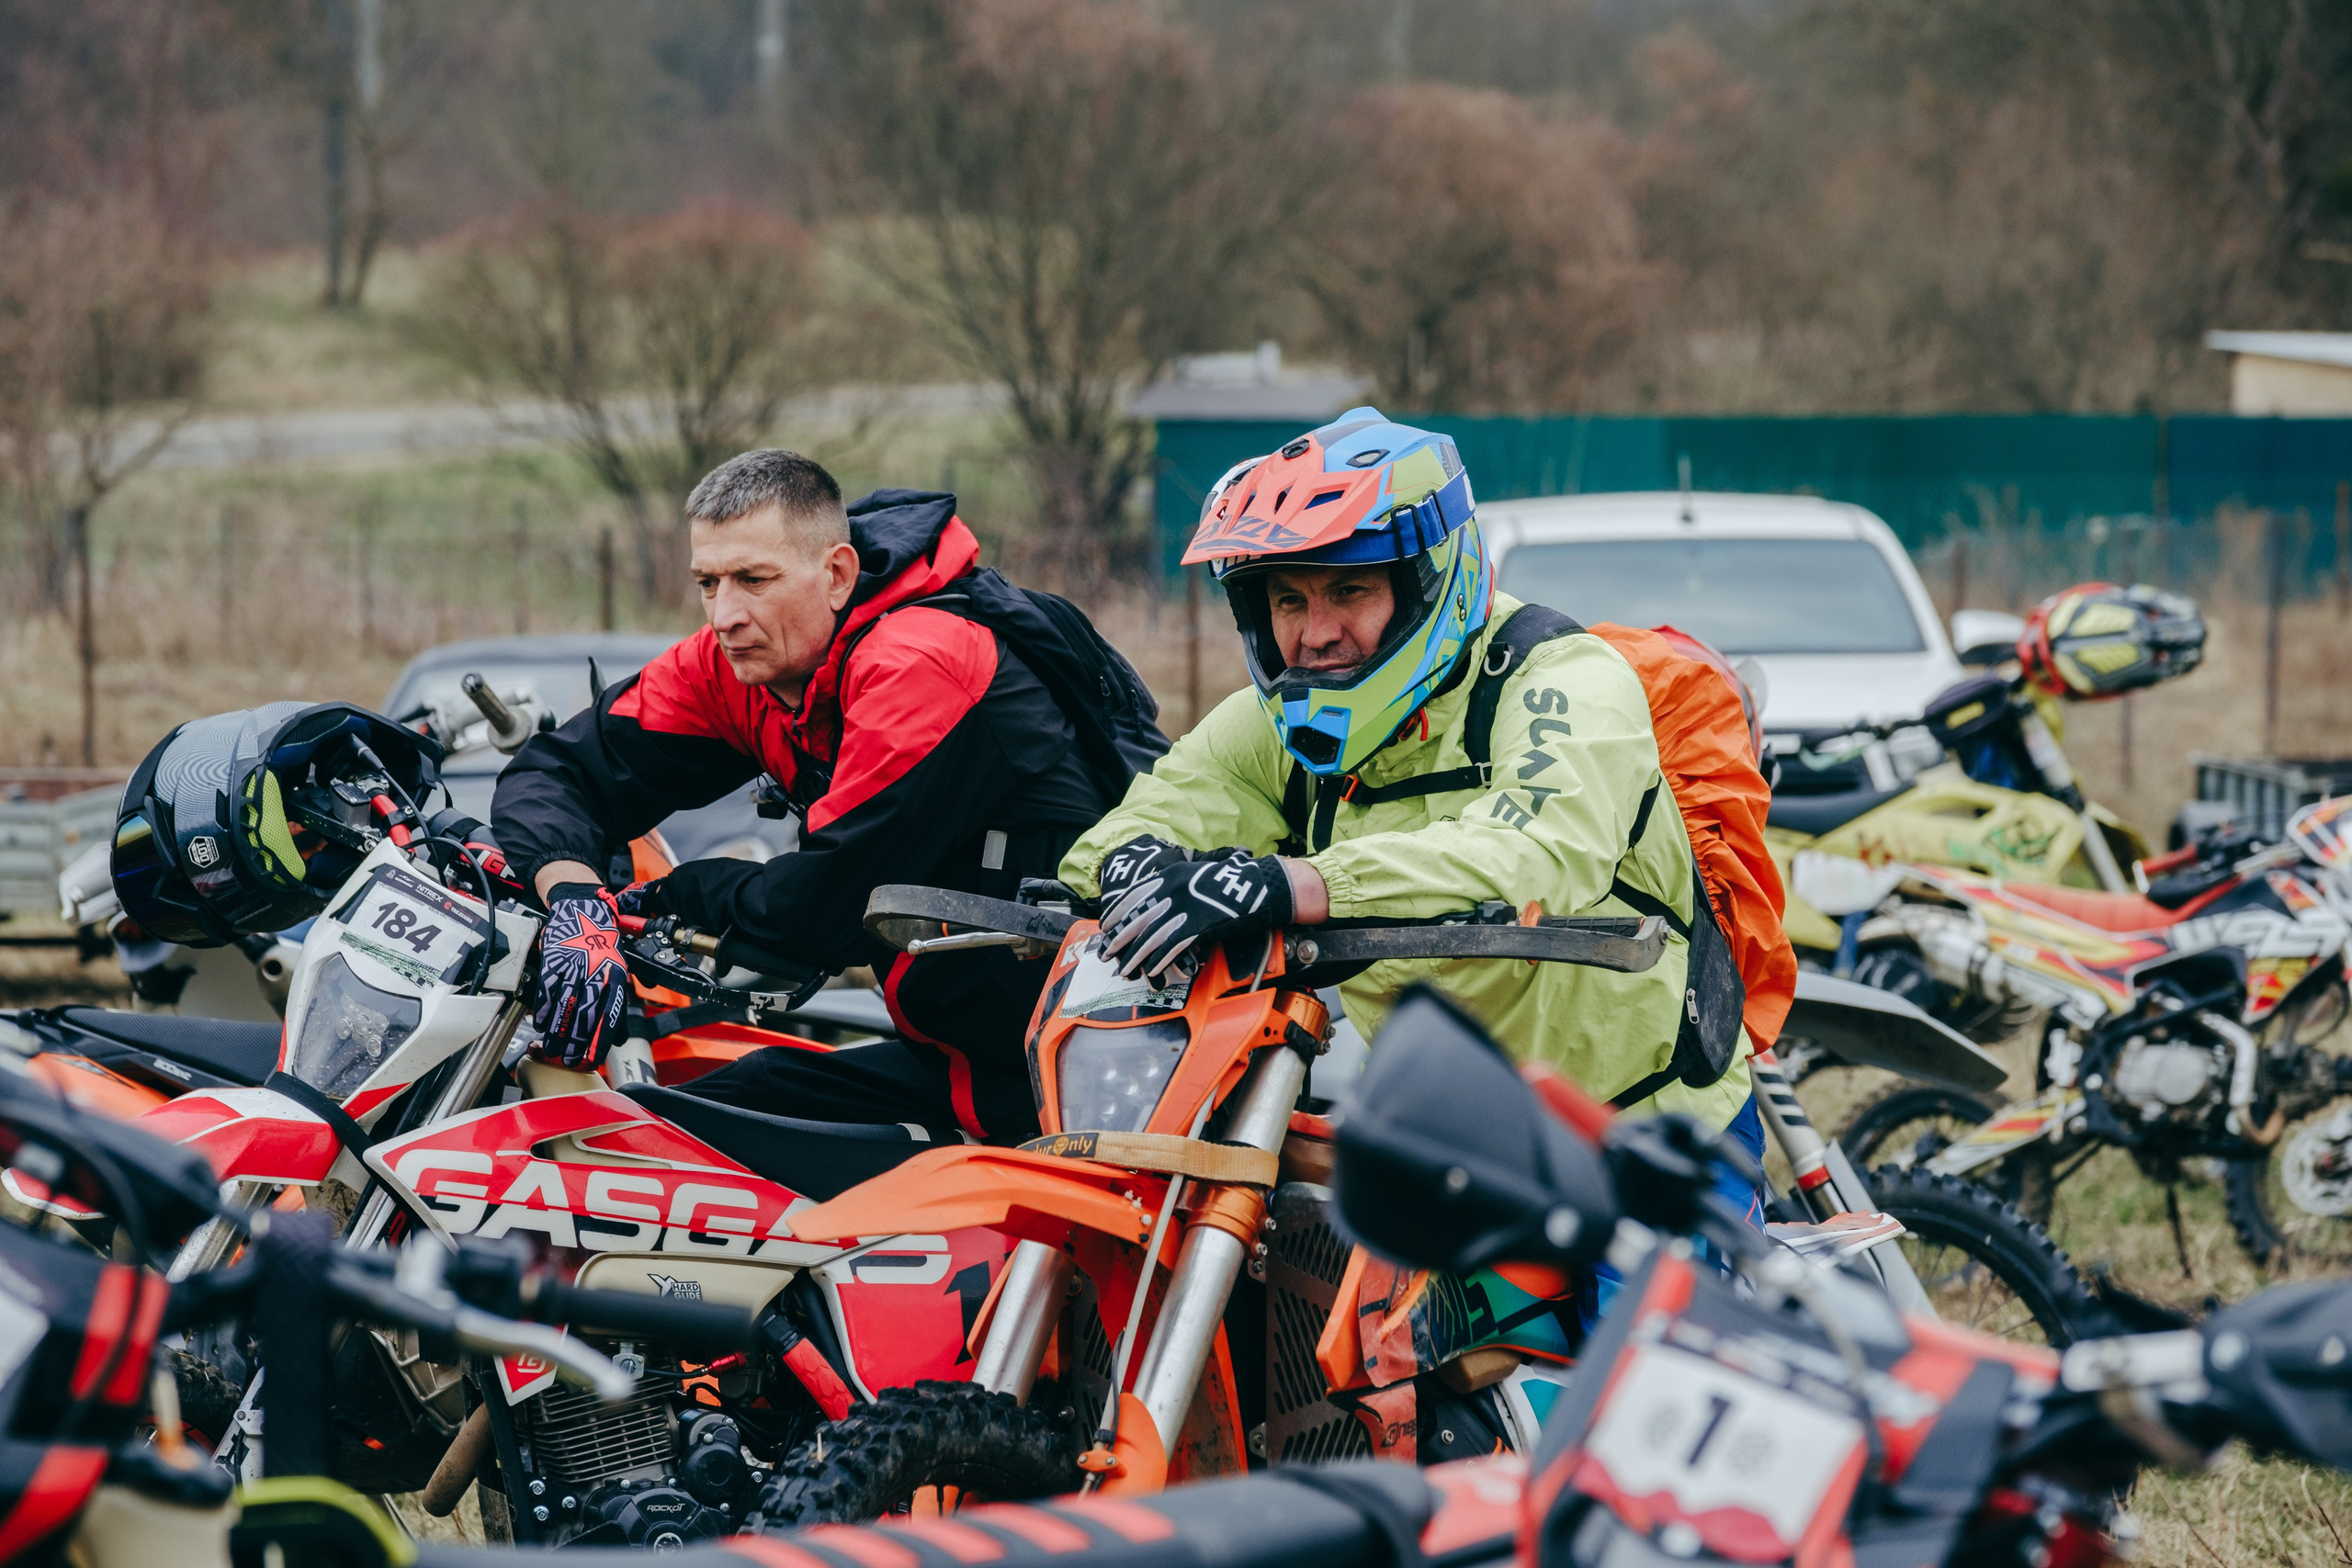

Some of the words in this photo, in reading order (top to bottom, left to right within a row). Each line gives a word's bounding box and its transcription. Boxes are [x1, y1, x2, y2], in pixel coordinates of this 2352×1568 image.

[196, 842, 210, 863] DOT
[416, 884, 444, 902] NITREX
[371, 901, 443, 954] 184
[395, 1148, 953, 1285] GASGAS
[673, 1283, 699, 1292] HARD
[673, 1292, 701, 1300] GLIDE
[1688, 1395, 1731, 1466] 1
[646, 1503, 685, 1514] ROCKOT
